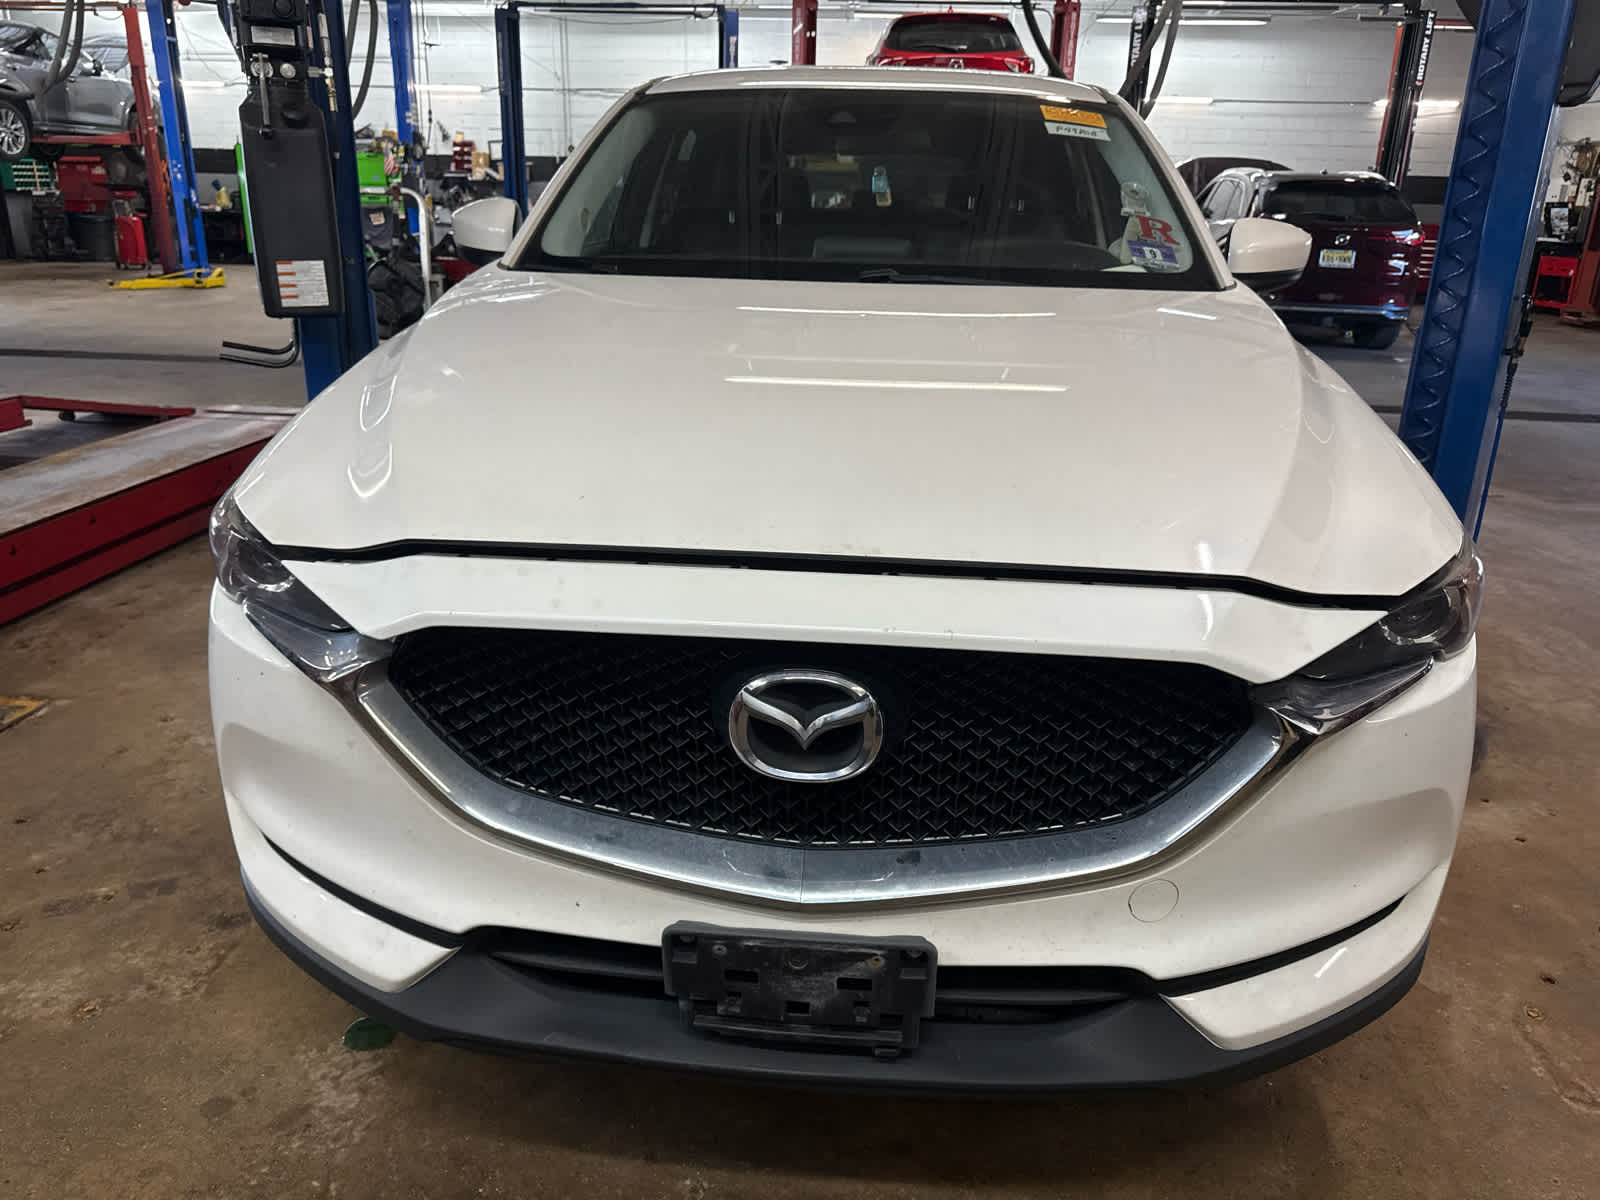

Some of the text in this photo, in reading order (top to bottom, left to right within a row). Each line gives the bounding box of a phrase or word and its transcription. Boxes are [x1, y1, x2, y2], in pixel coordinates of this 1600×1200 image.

[1417, 11, 1435, 80] ROTARY LIFT
[1136, 215, 1180, 246] R
